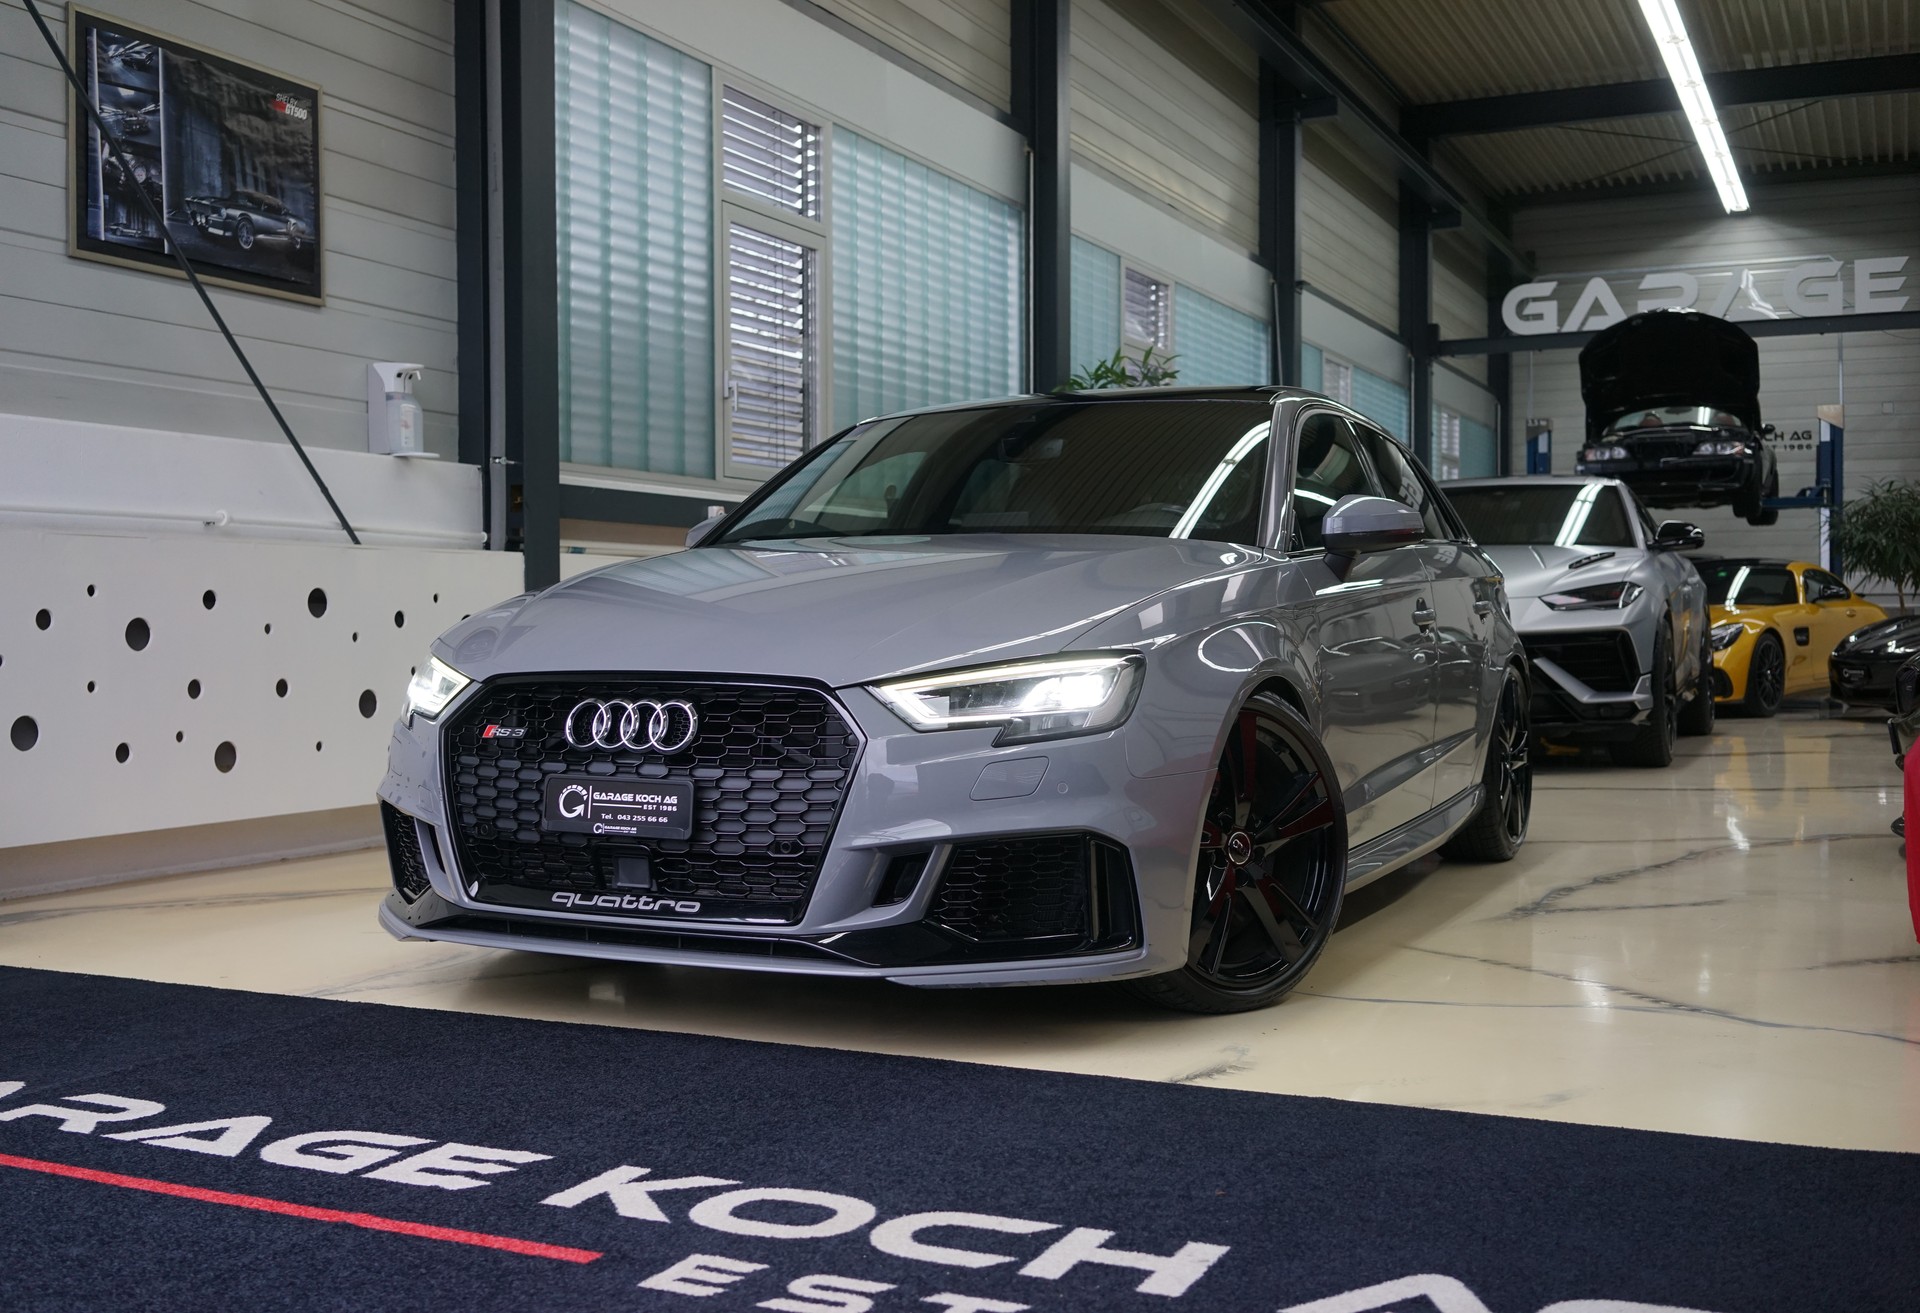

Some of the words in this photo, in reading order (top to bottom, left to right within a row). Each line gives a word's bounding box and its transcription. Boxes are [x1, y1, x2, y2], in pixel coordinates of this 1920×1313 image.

[275, 93, 298, 106] SHELBY
[285, 104, 308, 120] GT500
[1501, 255, 1910, 335] GARAGE
[1789, 430, 1812, 441] AG
[489, 728, 511, 737] RS
[512, 728, 525, 737] 3
[593, 791, 634, 802] GARAGE
[635, 794, 662, 804] KOCH
[663, 796, 678, 804] AG
[551, 891, 701, 913] quattro
[0, 1081, 554, 1190] RAGE
[540, 1165, 1231, 1299] KOCH
